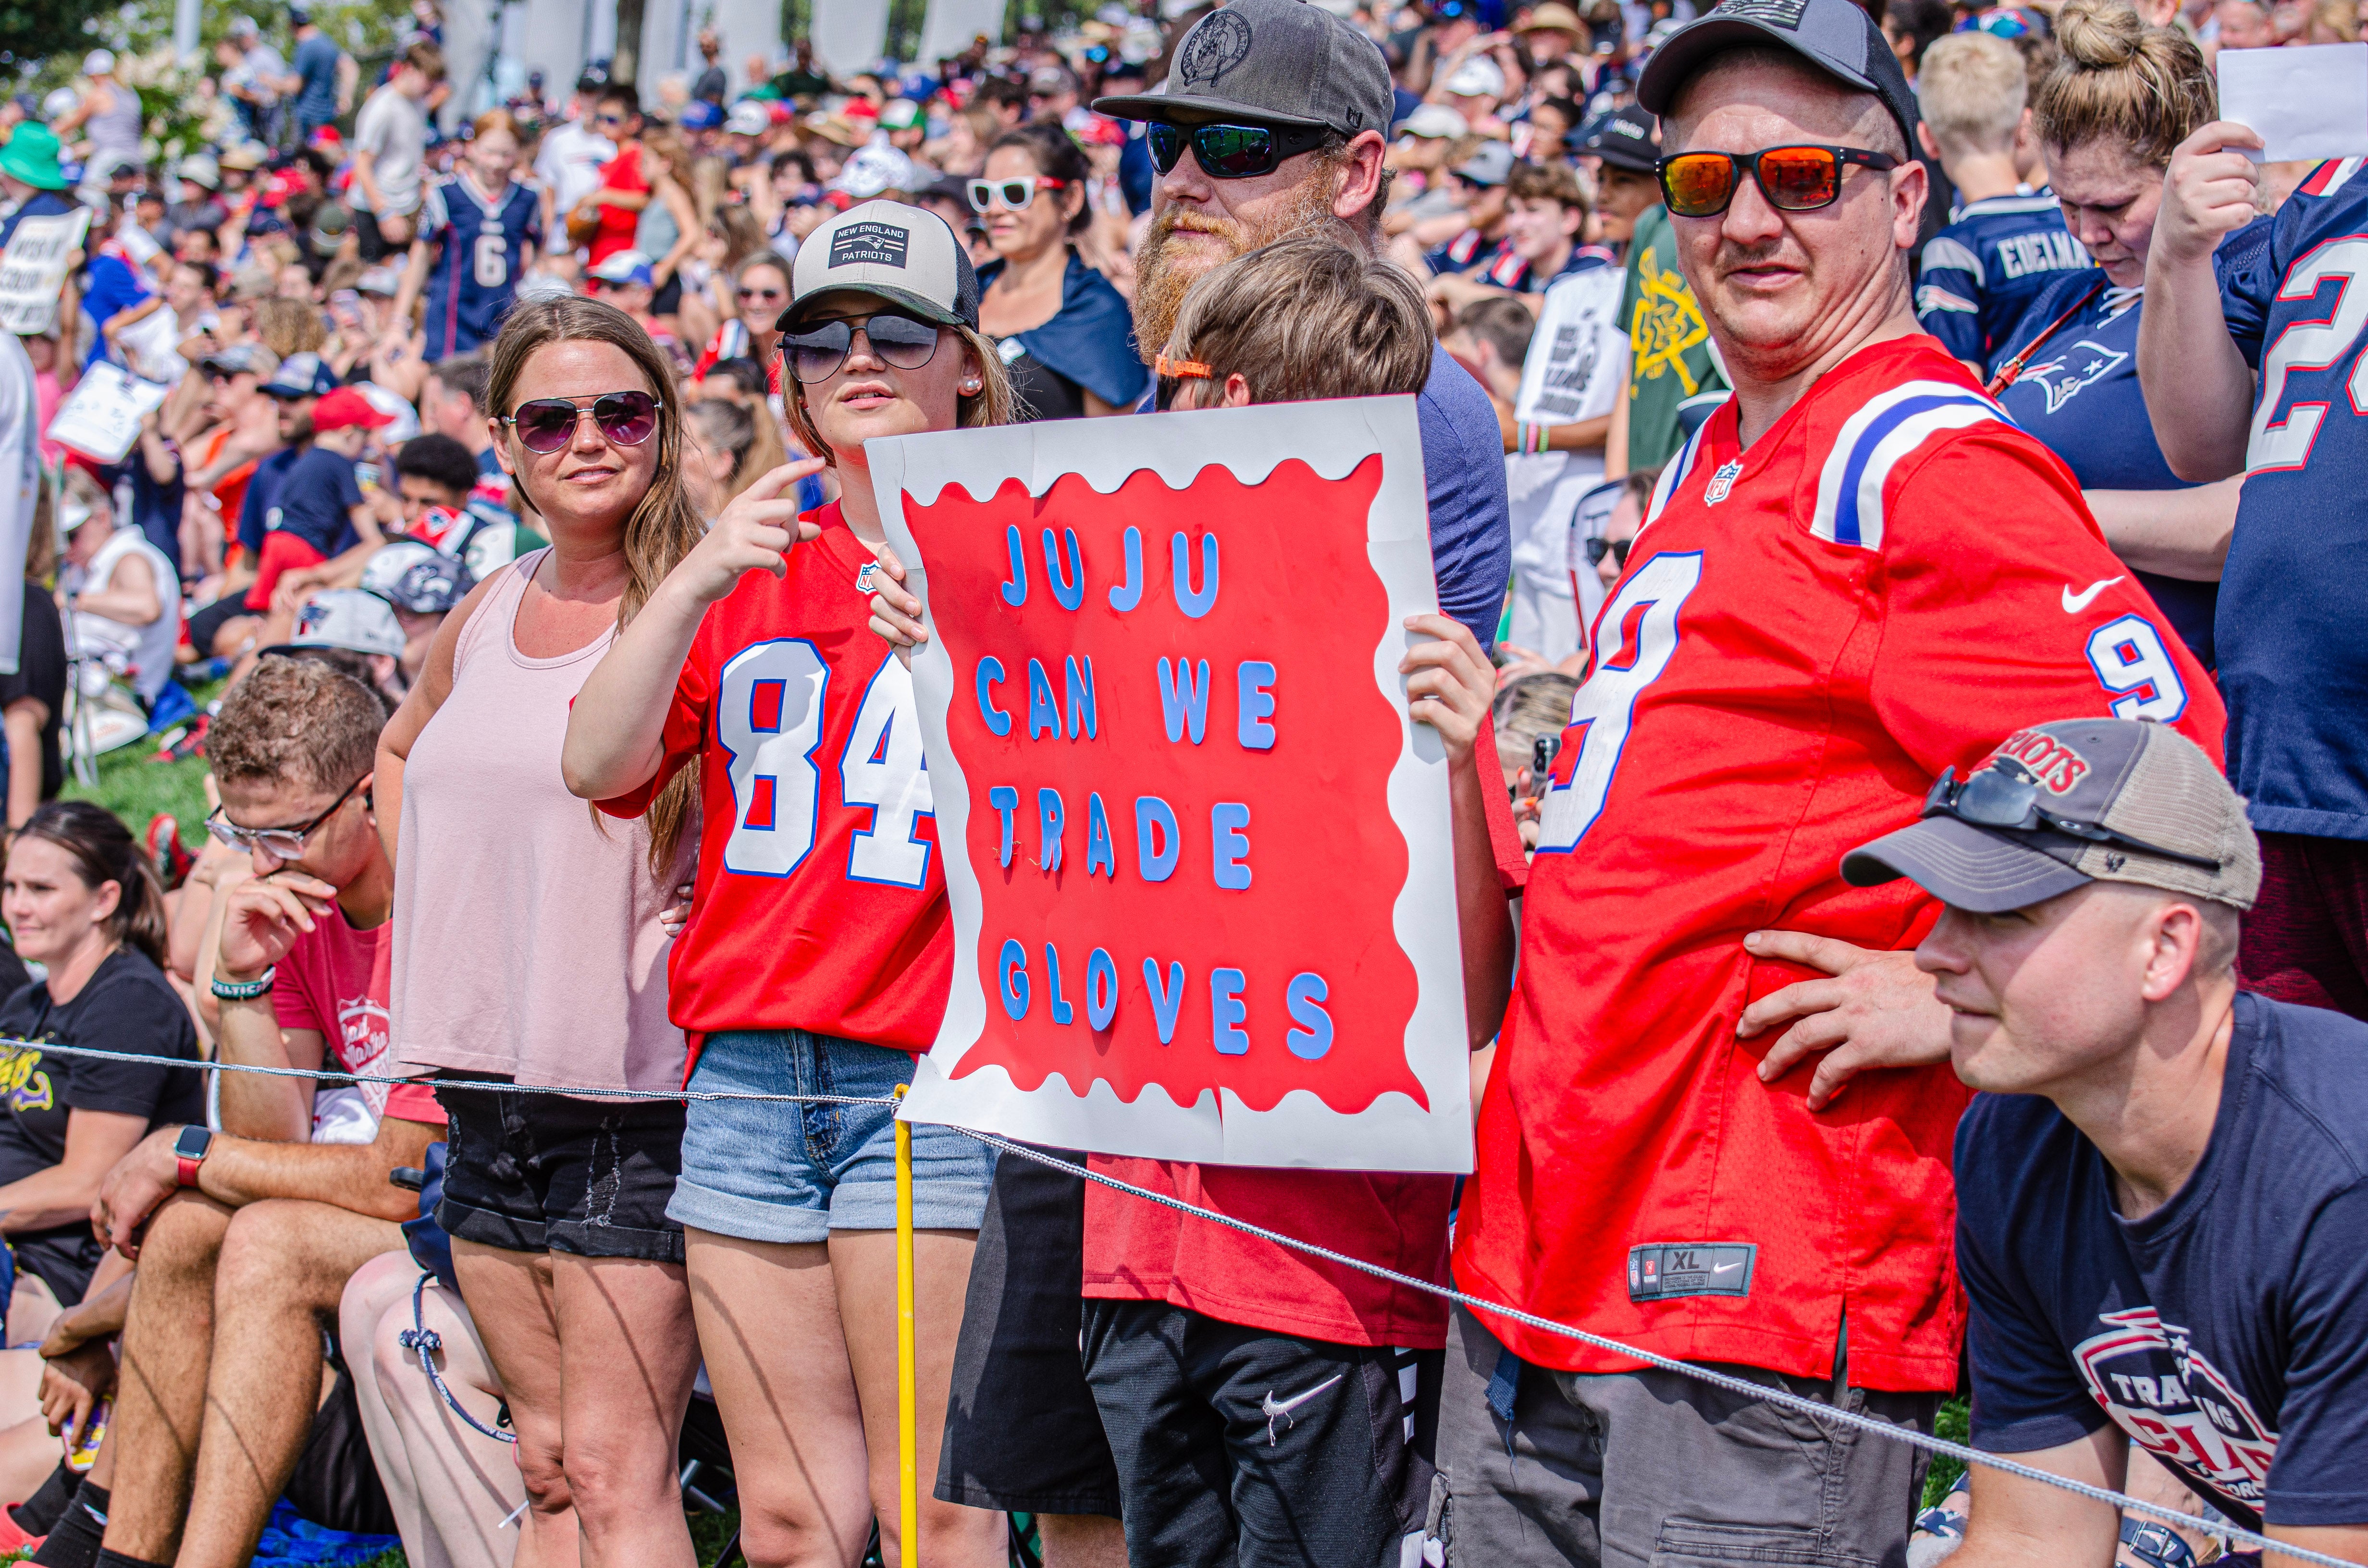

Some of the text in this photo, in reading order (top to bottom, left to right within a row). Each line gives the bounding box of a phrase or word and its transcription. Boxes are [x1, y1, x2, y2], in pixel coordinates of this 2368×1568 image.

[1231, 23, 1248, 60] CELTICS
[474, 234, 507, 288] 6
[838, 225, 904, 238] NEW ENGLAND
[842, 250, 892, 262] PATRIOTS
[2245, 233, 2368, 479] 2
[1708, 480, 1727, 498] NFL
[976, 654, 1276, 749] CAN WE
[1535, 549, 1704, 854] 9
[2084, 613, 2189, 723] 9
[716, 637, 936, 891] 84
[989, 786, 1252, 890] TRADE
[999, 939, 1333, 1060] GLOVES
[1671, 1251, 1700, 1270] XL
